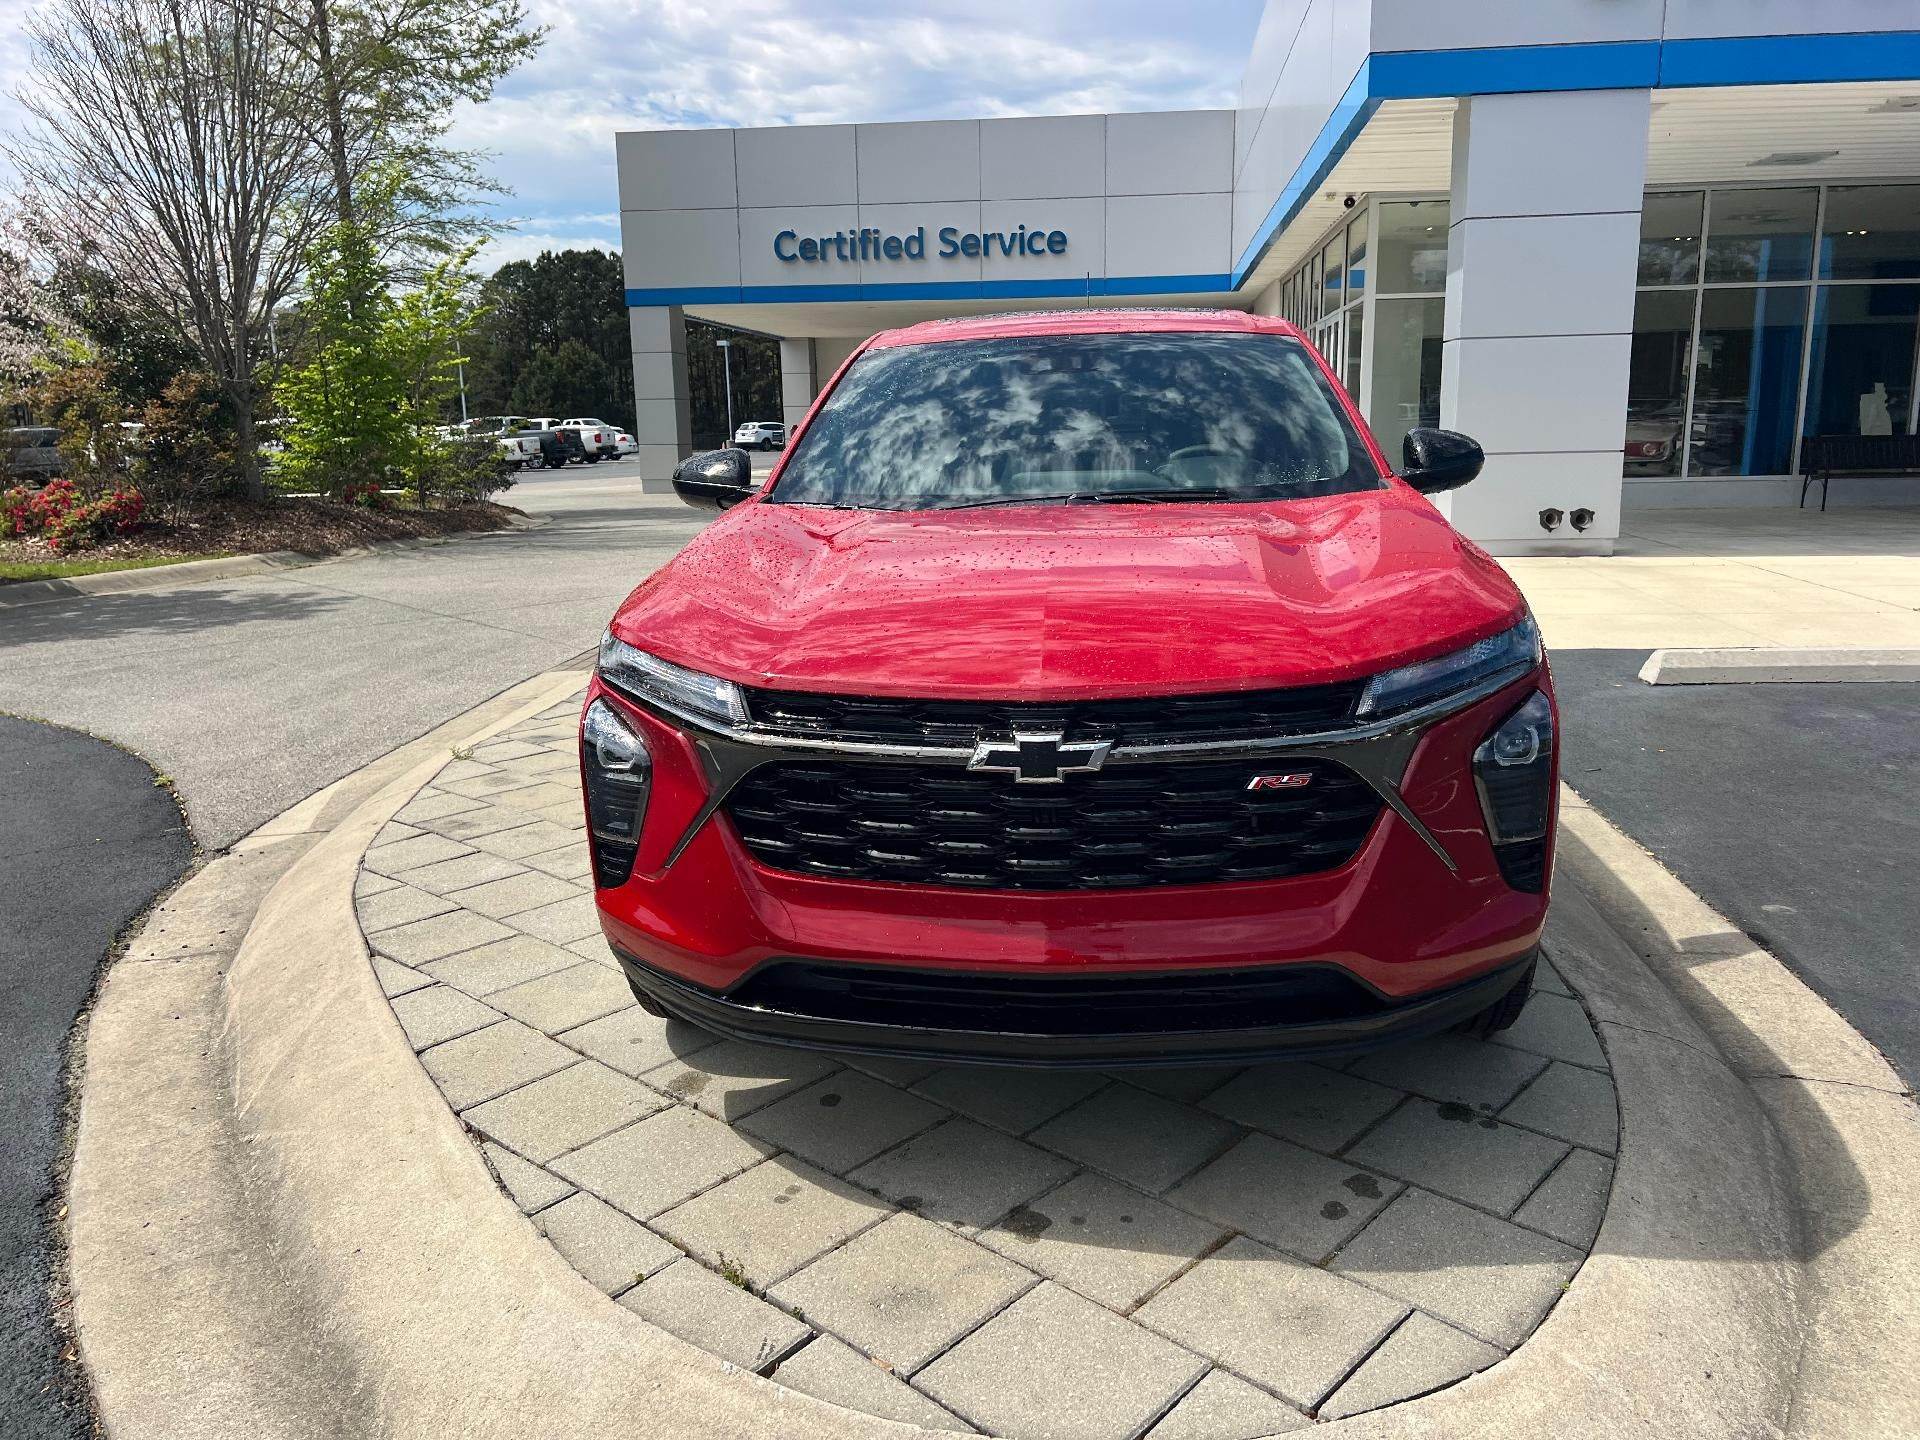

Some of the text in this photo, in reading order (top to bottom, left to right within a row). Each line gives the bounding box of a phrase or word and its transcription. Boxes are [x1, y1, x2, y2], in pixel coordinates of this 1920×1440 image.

[773, 224, 1068, 262] Certified Service
[1245, 773, 1312, 790] RS
